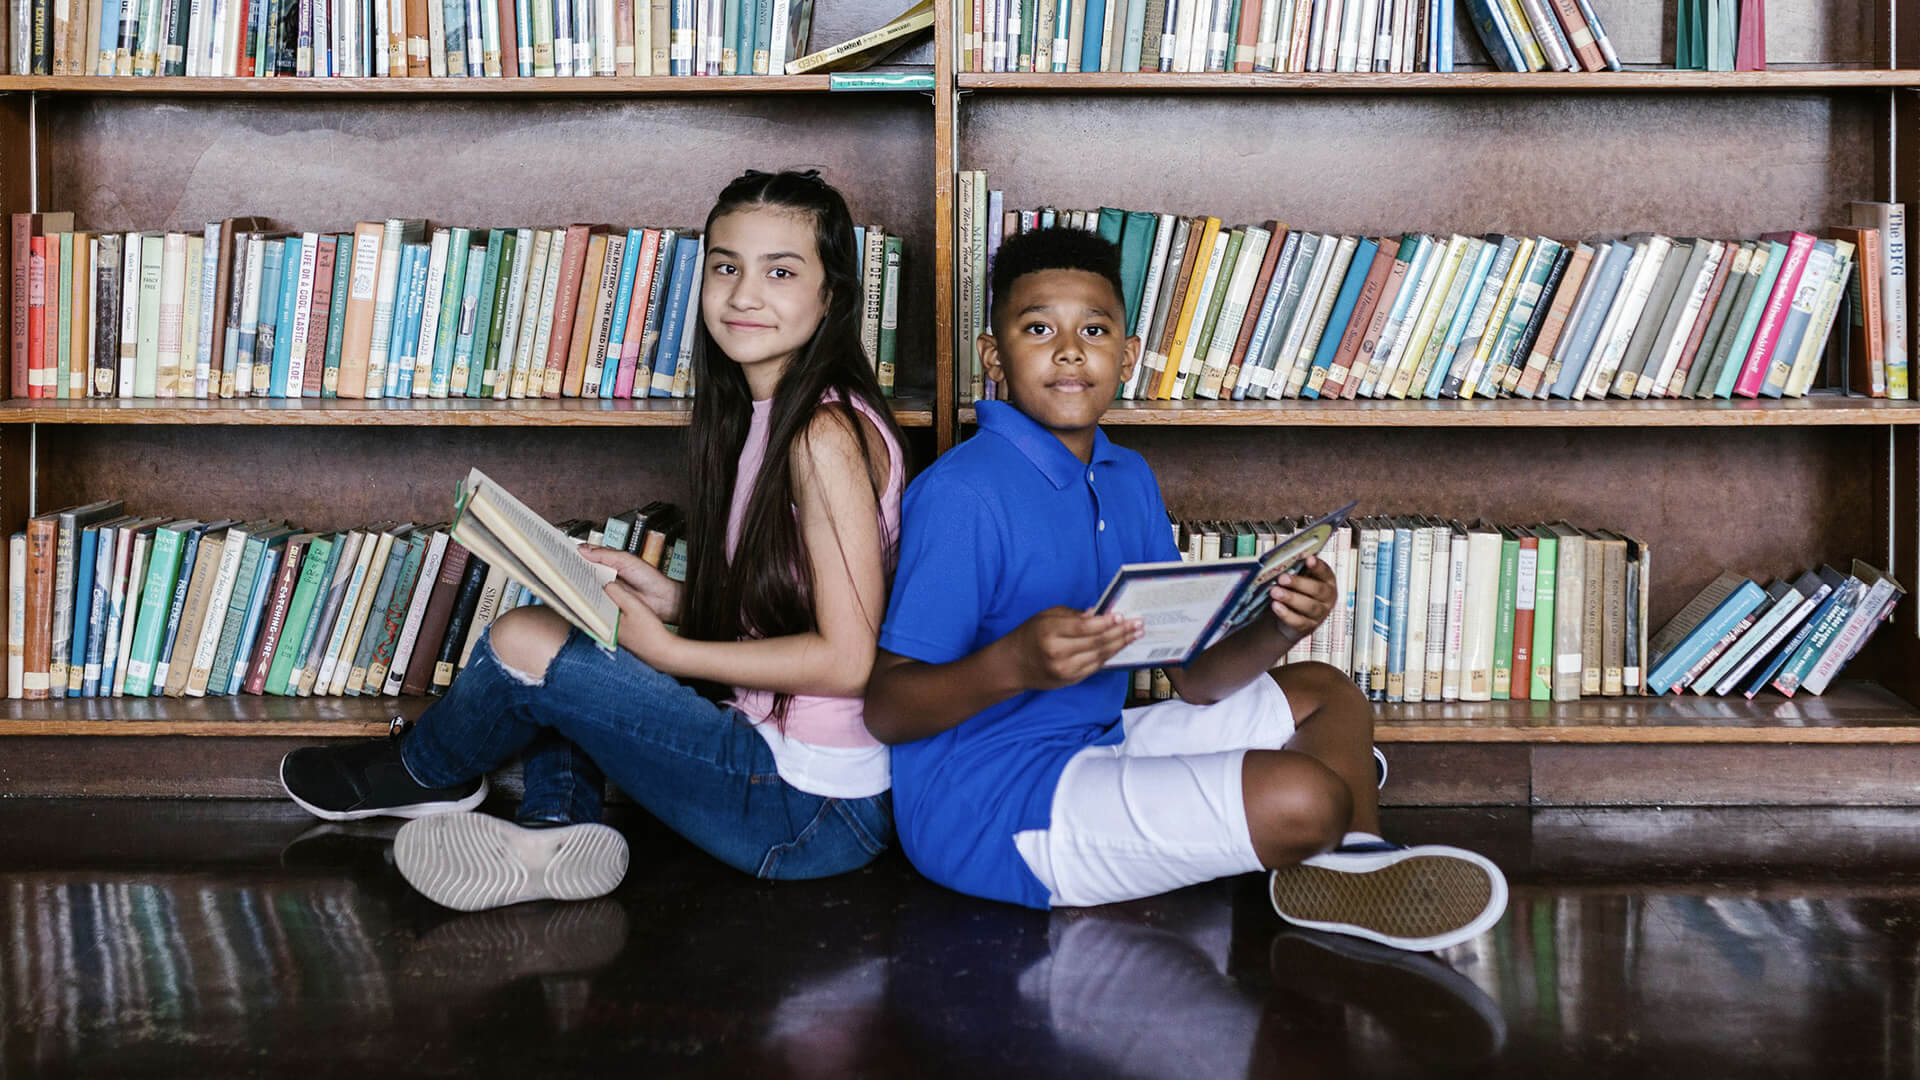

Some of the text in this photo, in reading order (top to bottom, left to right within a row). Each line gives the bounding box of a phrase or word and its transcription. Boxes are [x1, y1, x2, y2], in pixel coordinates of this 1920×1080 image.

[33, 7, 45, 55] EXPLOSIVES
[796, 53, 823, 70] USED
[960, 179, 971, 202] Justin
[960, 207, 971, 242] Morgan
[962, 246, 972, 265] Had
[973, 226, 981, 261] MINN
[1888, 211, 1904, 275] The BFG
[302, 250, 312, 266] LIFE
[640, 248, 654, 287] Min-Min
[15, 265, 24, 303] TIGER
[300, 268, 310, 279] ON
[416, 279, 424, 294] Year
[622, 265, 631, 281] THE
[648, 251, 664, 300] Mysterious
[866, 239, 883, 319] ROW OF TIGERS
[1366, 279, 1378, 294] The
[297, 289, 308, 309] COOL
[334, 280, 344, 313] SUMMER
[961, 276, 971, 301] Horse
[1269, 281, 1281, 298] THE
[414, 296, 422, 313] Mom
[559, 285, 571, 322] CARNIVAL
[594, 241, 622, 368] THE MYSTERY OF THE BURIED INDIA
[615, 285, 628, 323] HUNDRED
[14, 305, 24, 336] EYES
[294, 312, 305, 343] PLASTIC
[1246, 341, 1261, 366] HORS
[1343, 329, 1358, 353] Sword
[290, 361, 300, 380] FLOE
[219, 547, 238, 573] Young
[424, 552, 439, 578] Cooney
[215, 574, 230, 596] Hans
[1395, 535, 1410, 620] A Trumpet Sounds
[167, 579, 187, 630] FAST EDDIE
[476, 586, 497, 622] SMOKE
[262, 585, 288, 658] CATCHING FIRE
